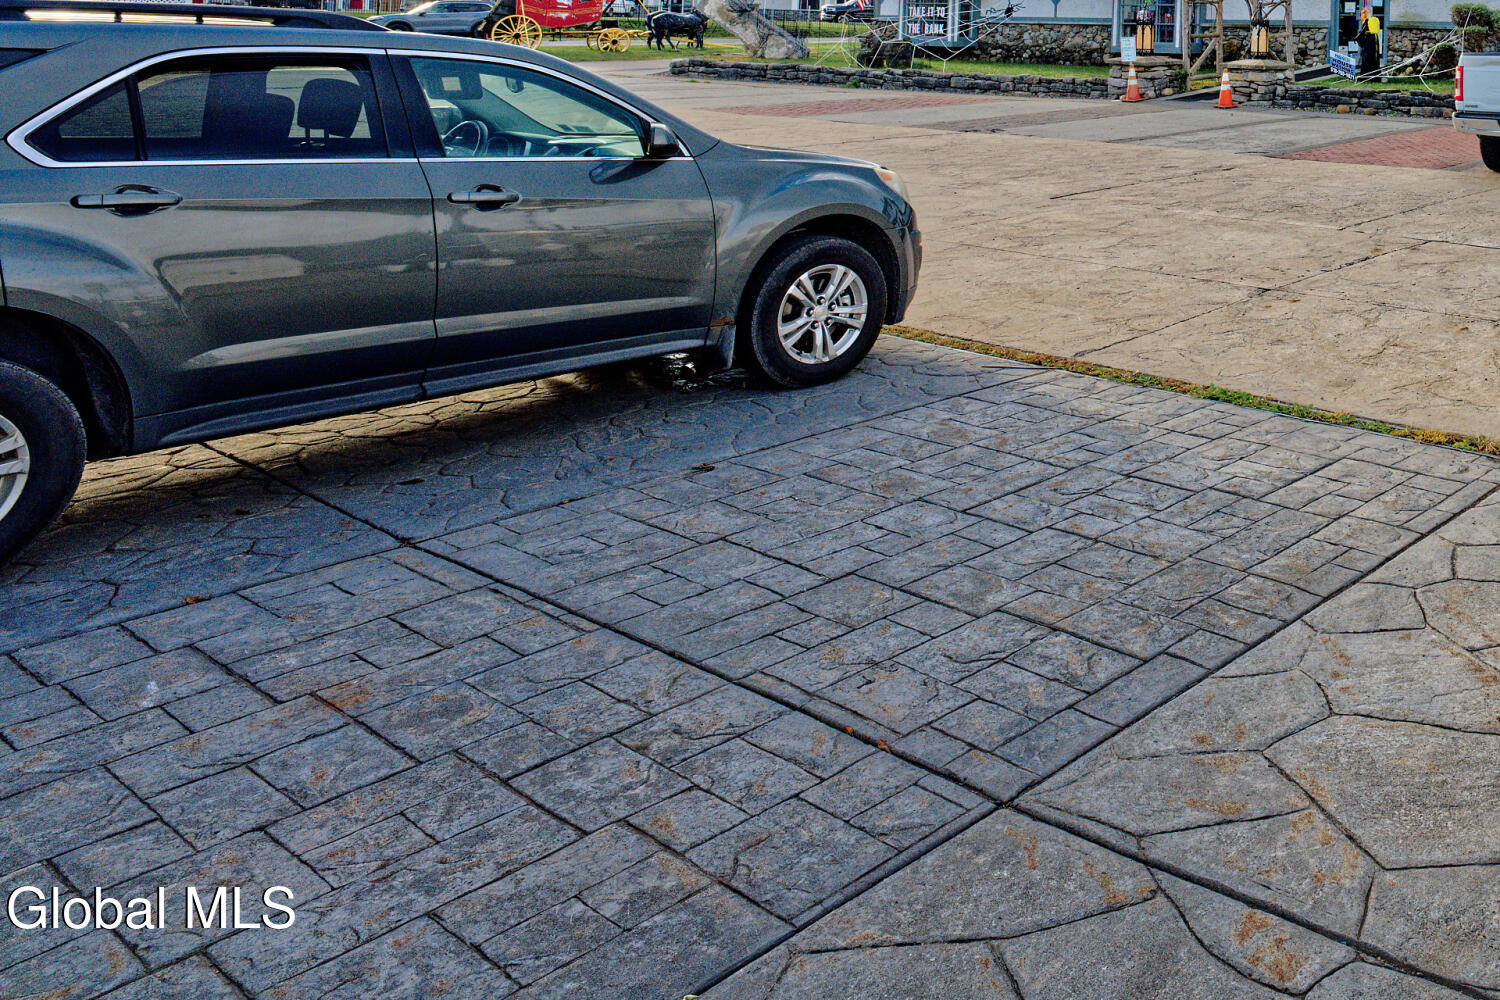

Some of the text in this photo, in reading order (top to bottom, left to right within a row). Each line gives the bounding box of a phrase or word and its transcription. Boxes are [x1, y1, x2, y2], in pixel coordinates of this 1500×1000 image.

[909, 6, 946, 17] TAKE IT TO
[908, 23, 945, 34] THE BANK
